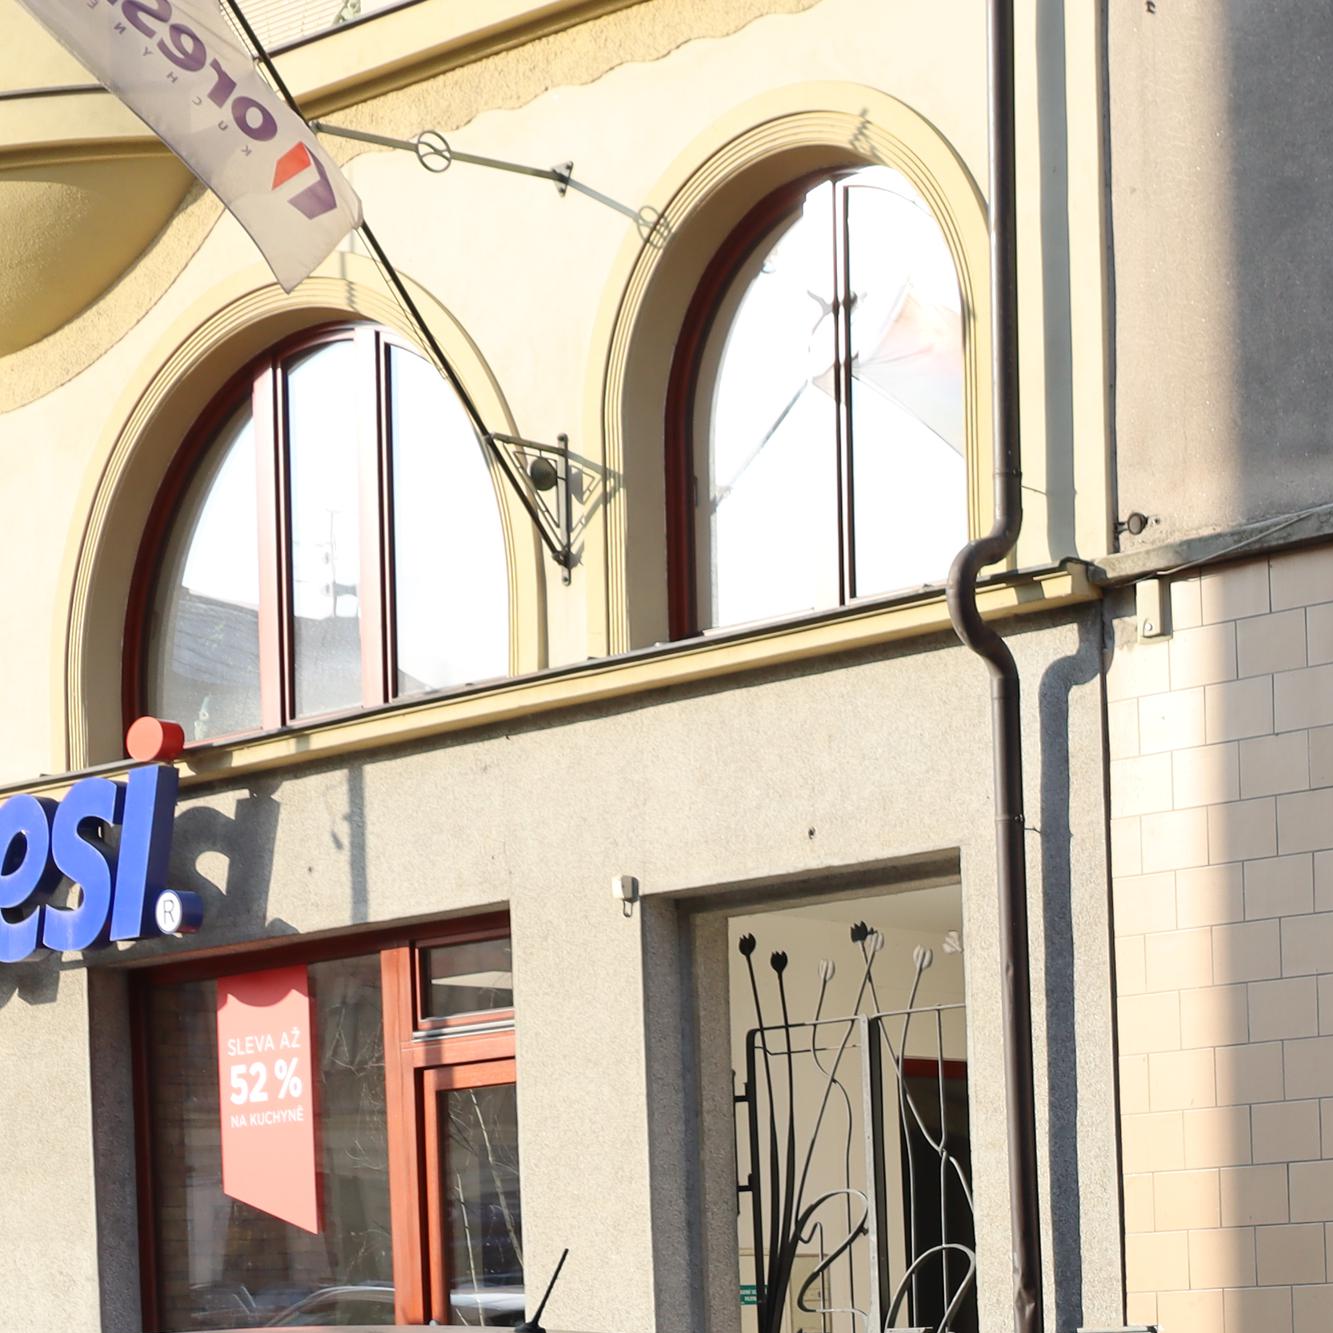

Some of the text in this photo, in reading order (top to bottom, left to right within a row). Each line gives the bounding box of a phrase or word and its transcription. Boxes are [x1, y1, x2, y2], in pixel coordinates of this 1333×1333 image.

[227, 1026, 301, 1056] SLEVA AŽ
[229, 1056, 303, 1105] 52 %
[230, 1104, 304, 1129] NA KUCHYNĚ
